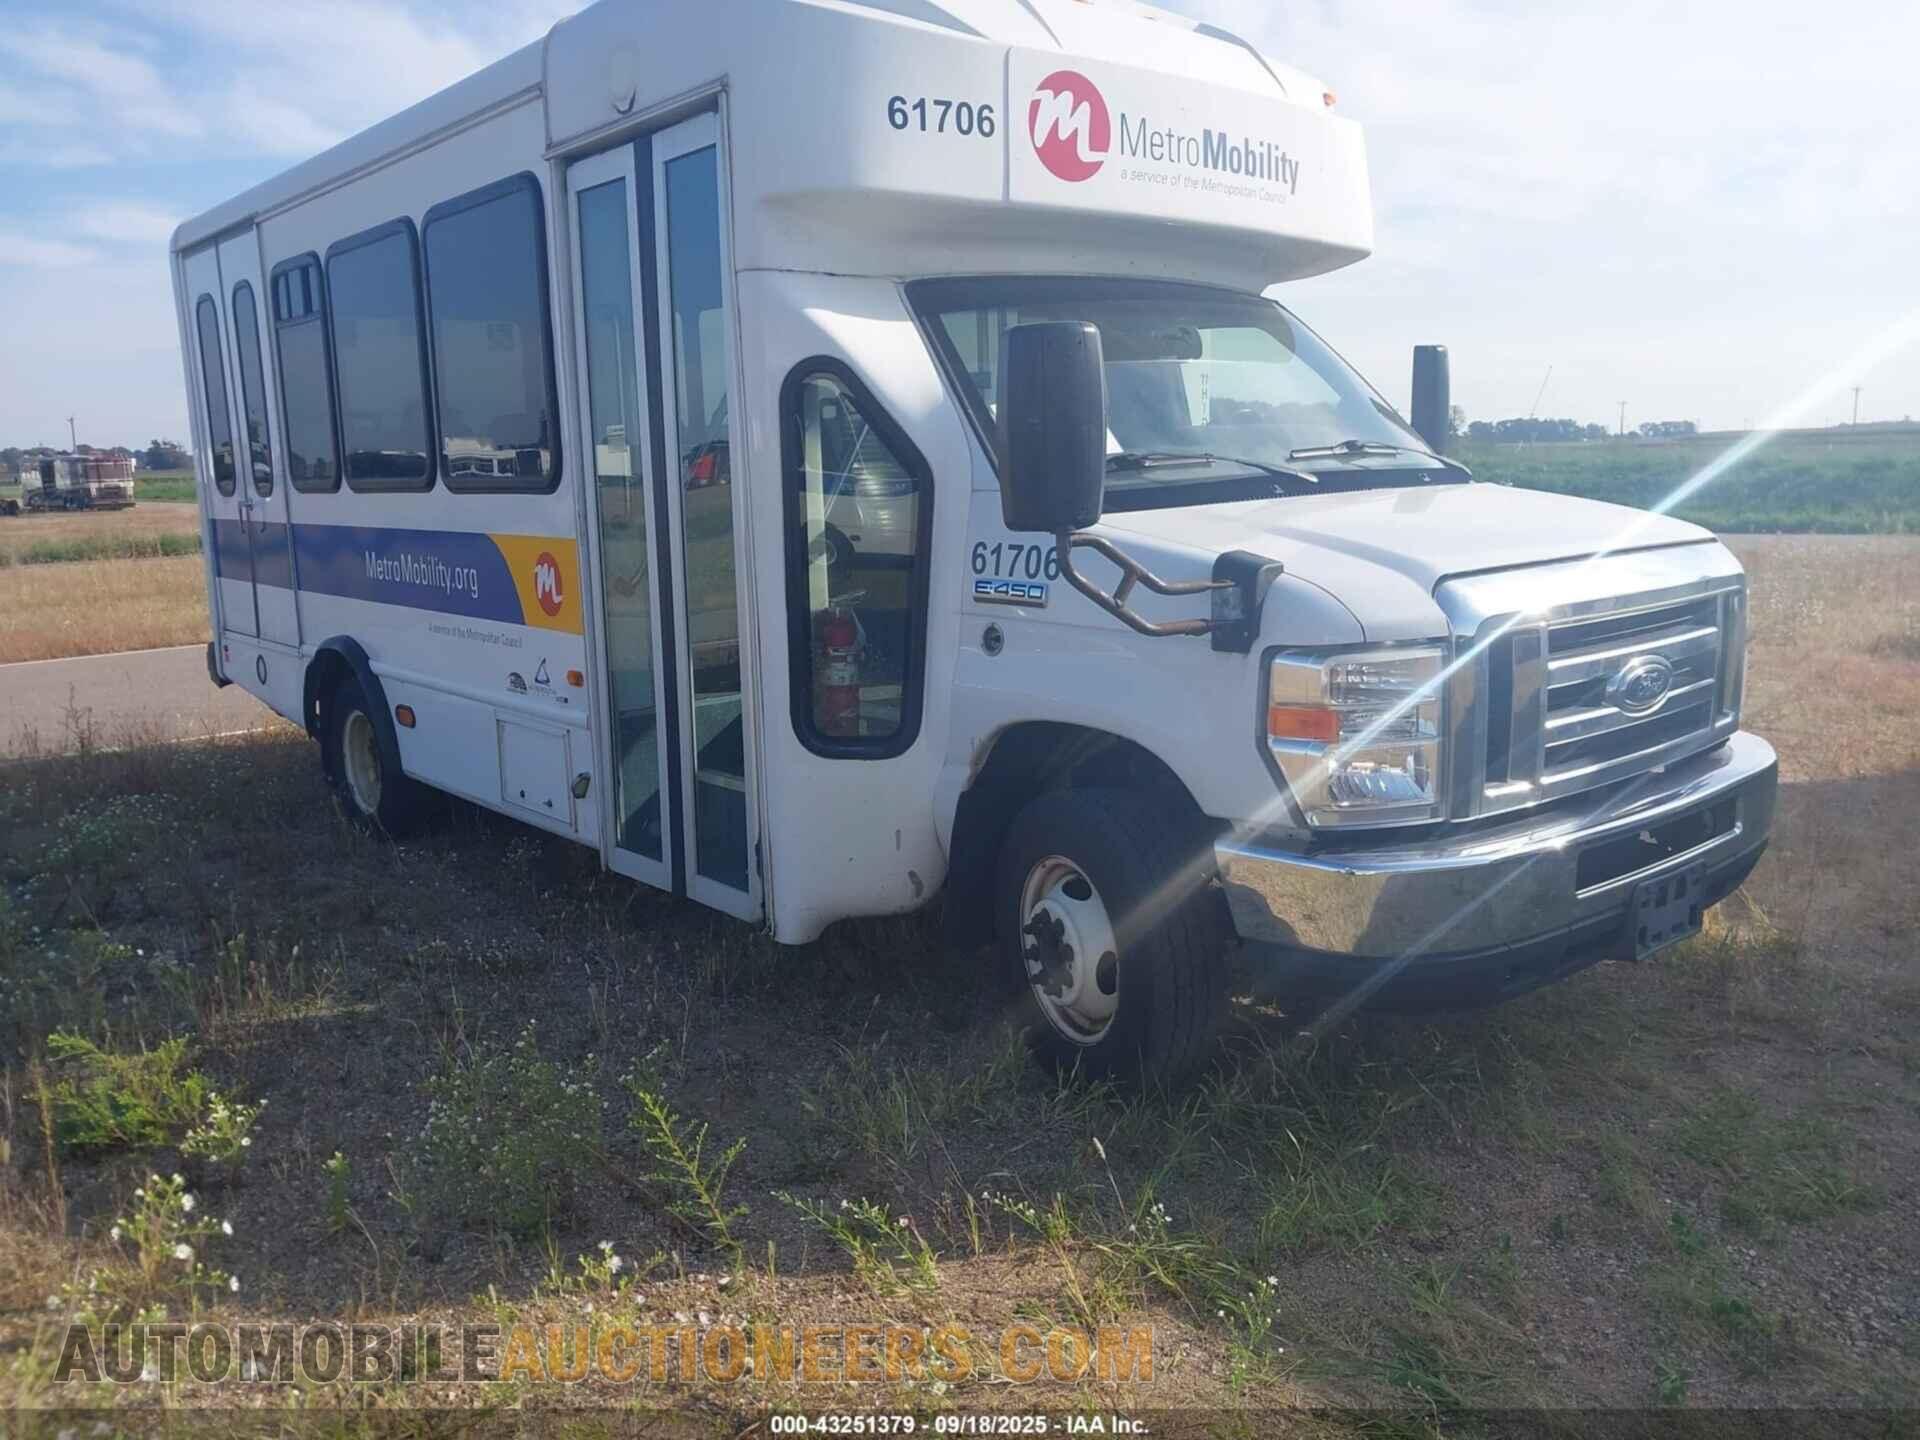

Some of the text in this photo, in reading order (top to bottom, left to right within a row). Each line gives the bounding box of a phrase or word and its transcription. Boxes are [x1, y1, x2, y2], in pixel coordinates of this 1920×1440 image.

[887, 95, 996, 138] 61706
[1119, 112, 1300, 196] MetroMobility
[1120, 169, 1128, 181] a
[1130, 170, 1168, 185] service
[1170, 174, 1182, 187] of
[1183, 175, 1200, 190] the
[364, 550, 479, 599] MetroMobility.org
[971, 541, 1061, 581] 61706
